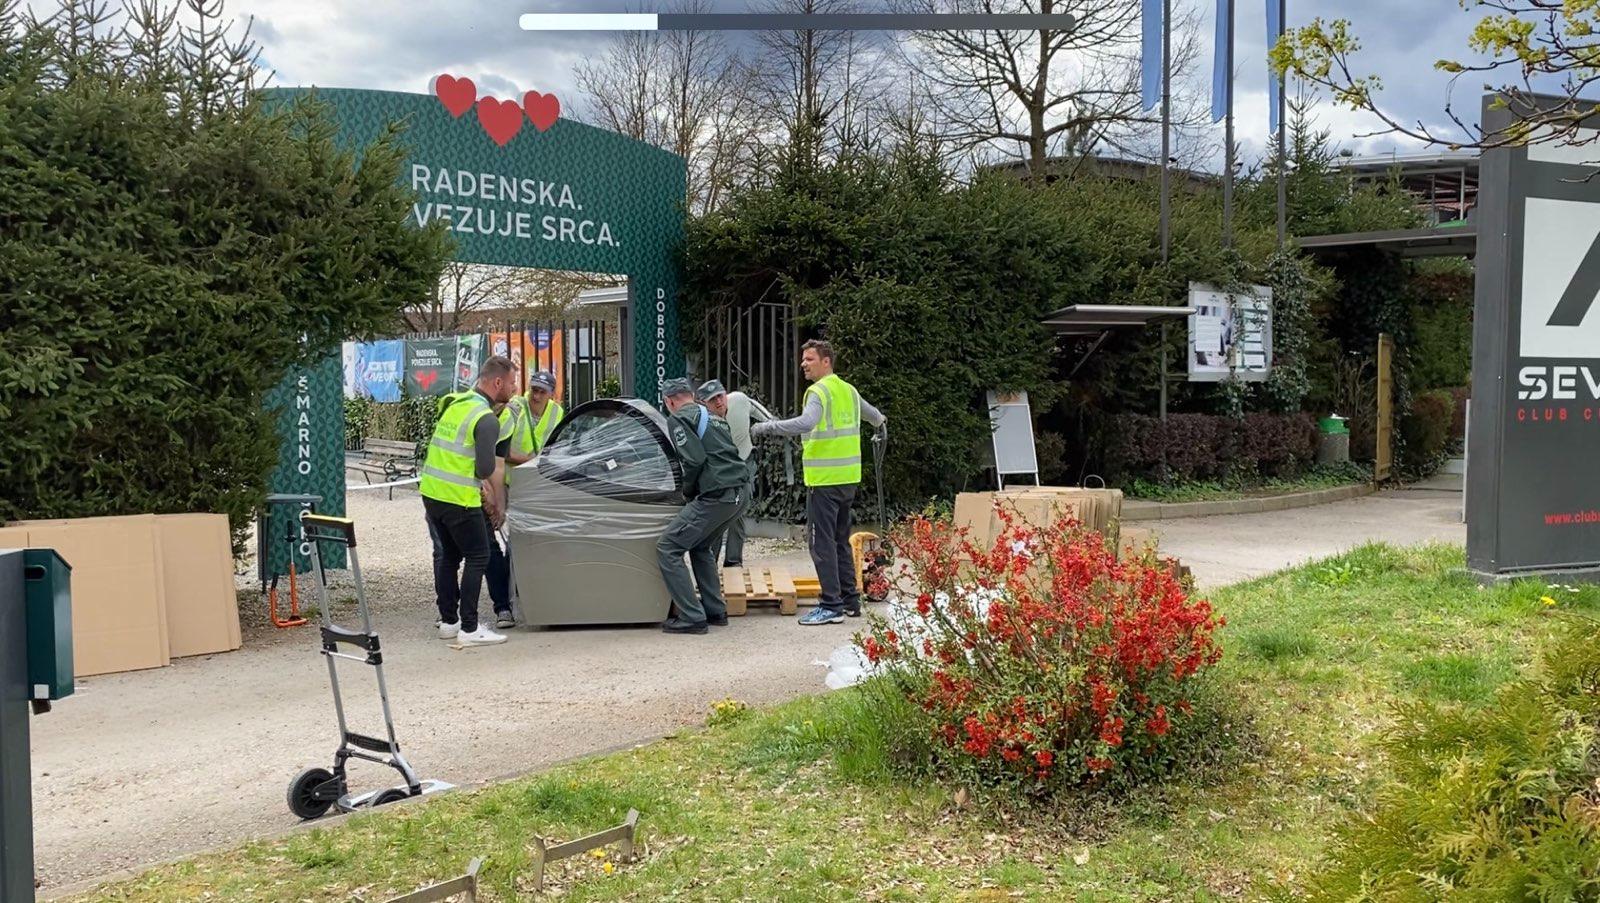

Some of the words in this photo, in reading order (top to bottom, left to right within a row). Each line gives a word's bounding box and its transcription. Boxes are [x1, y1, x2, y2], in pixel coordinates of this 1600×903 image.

[411, 163, 583, 211] RADENSKA.
[412, 202, 532, 239] VEZUJE
[541, 215, 621, 248] SRCA.
[1517, 407, 1568, 421] CLUB
[1583, 407, 1600, 421] C
[1543, 509, 1600, 525] www.club
